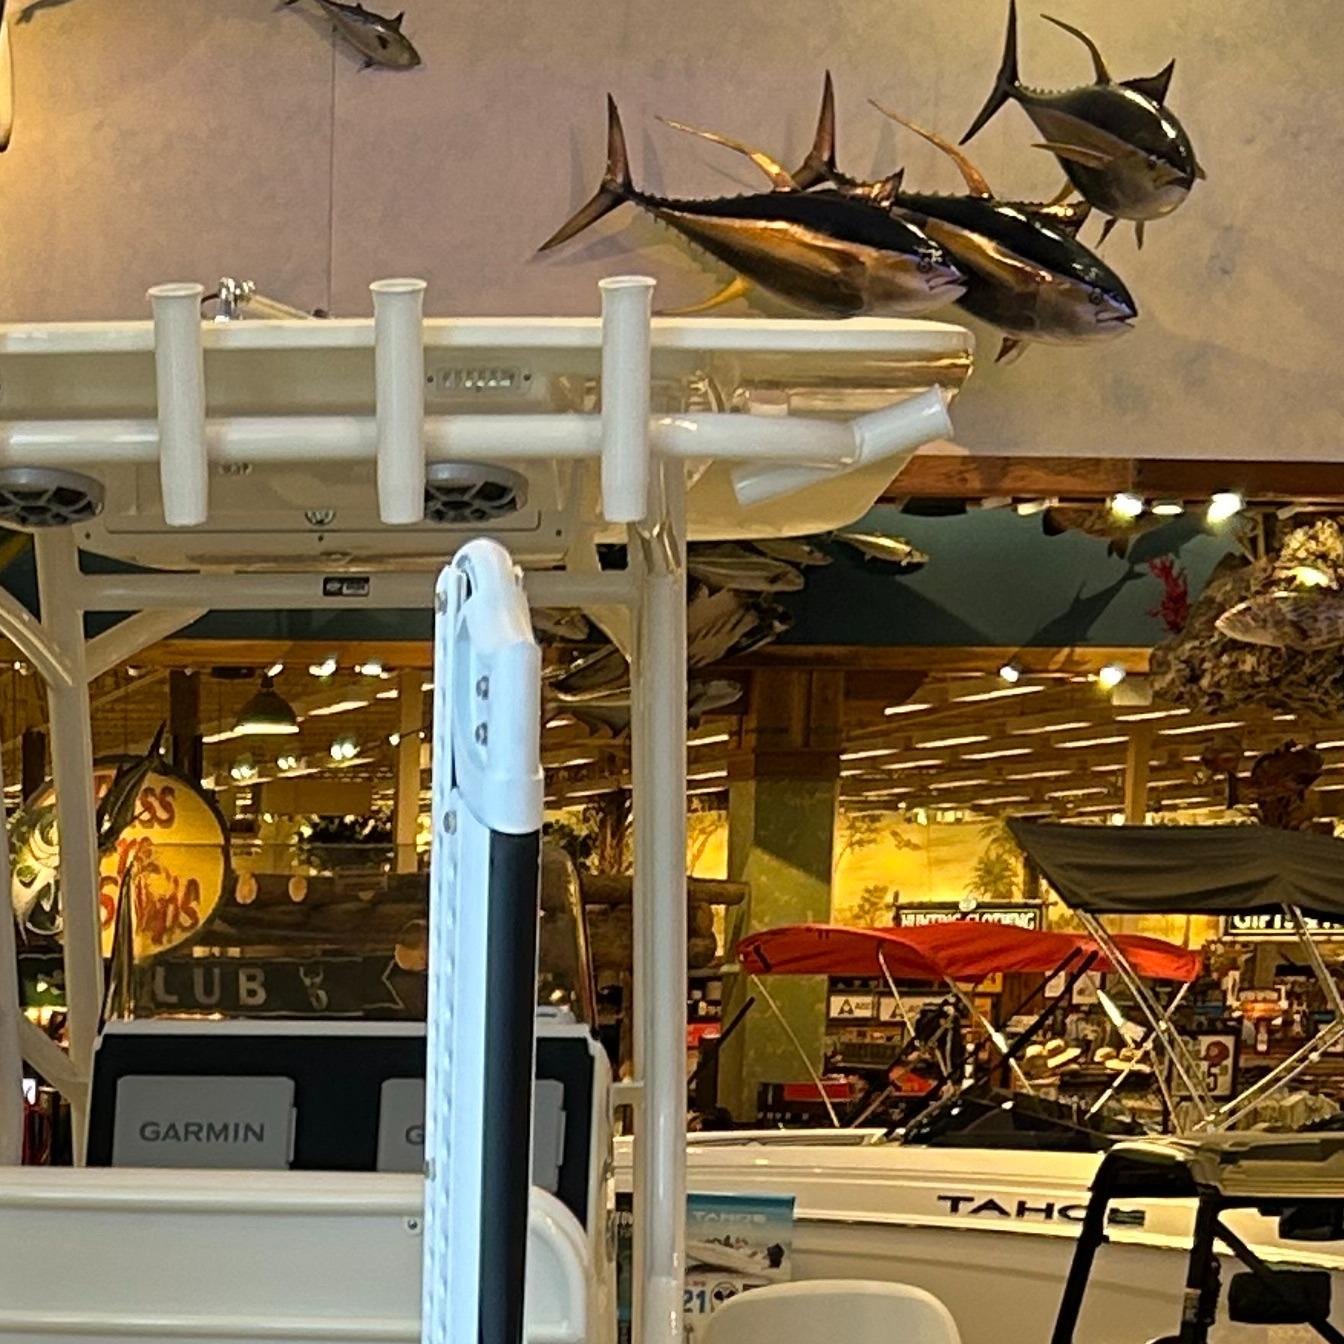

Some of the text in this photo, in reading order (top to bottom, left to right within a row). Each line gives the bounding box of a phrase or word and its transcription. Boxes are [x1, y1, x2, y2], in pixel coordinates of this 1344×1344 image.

[153, 965, 268, 1006] LUB
[138, 1120, 265, 1144] GARMIN
[692, 1210, 768, 1225] TAHOE
